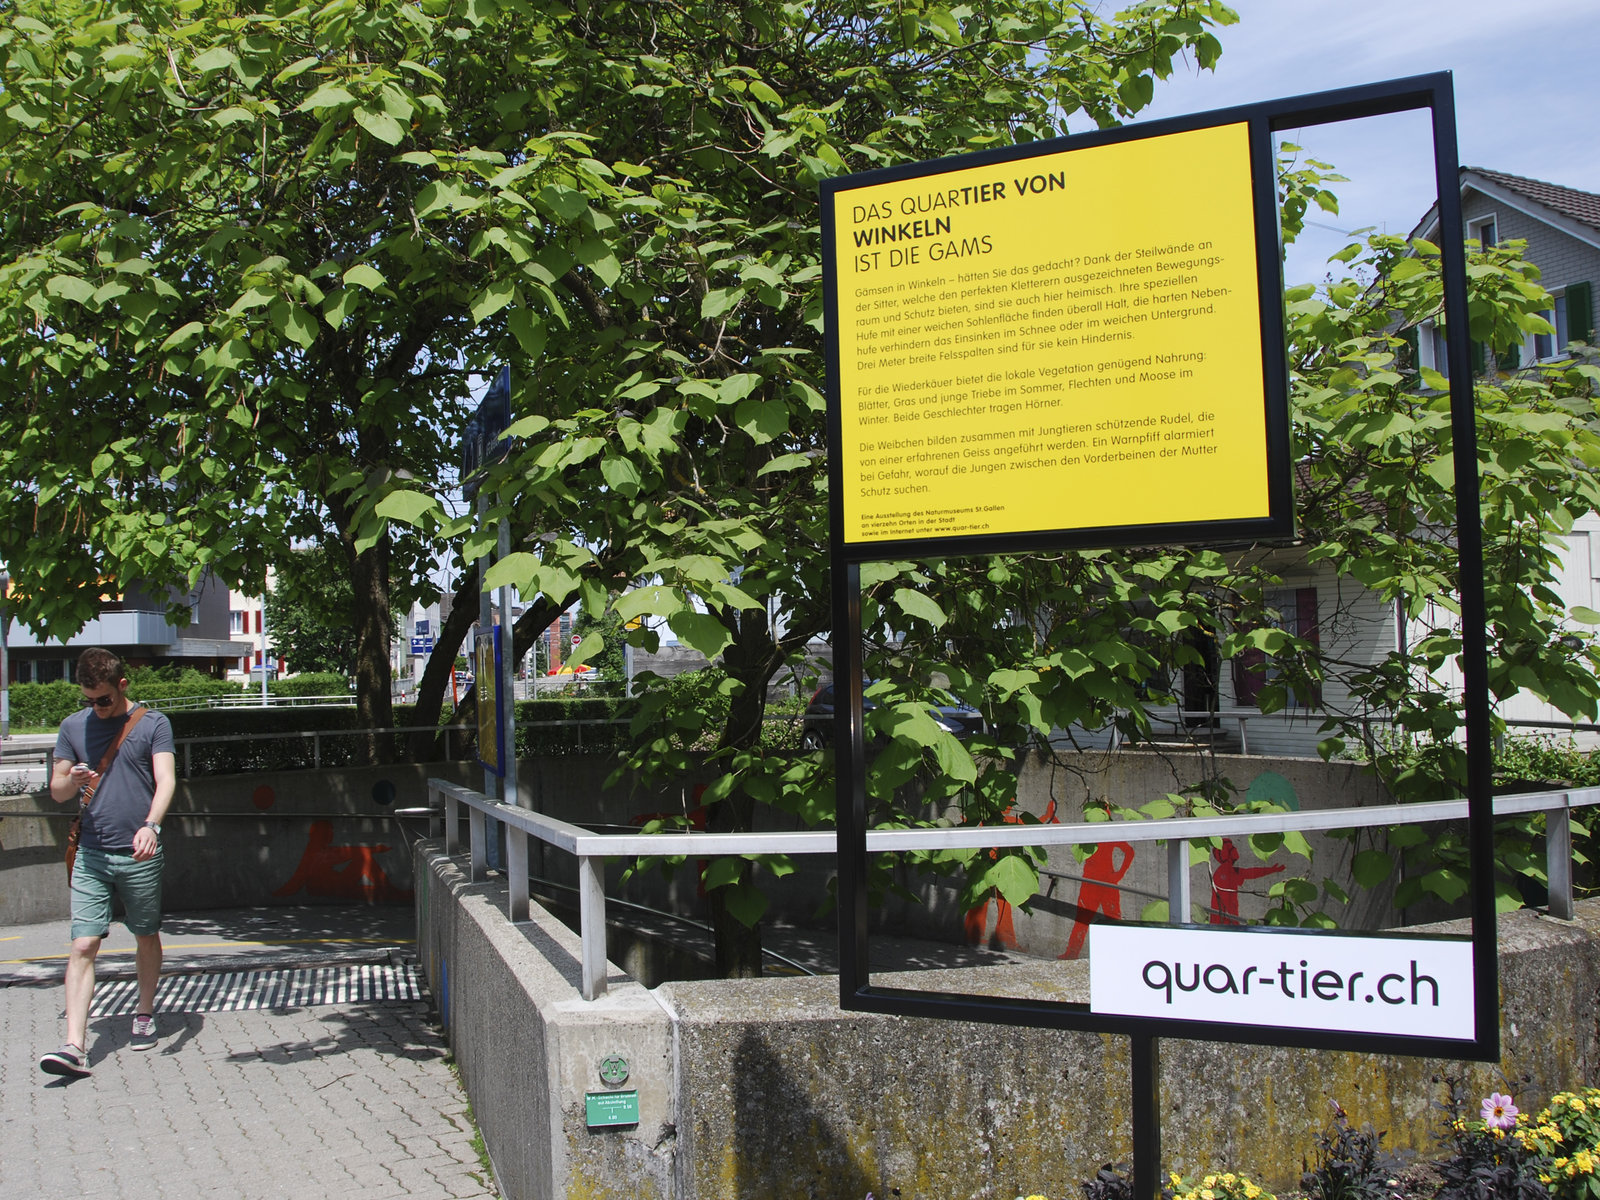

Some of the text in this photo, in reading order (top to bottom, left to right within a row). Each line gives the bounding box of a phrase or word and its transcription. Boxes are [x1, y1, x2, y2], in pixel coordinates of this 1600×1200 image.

[853, 171, 1065, 223] DAS QUARTIER VON
[853, 216, 950, 247] WINKELN
[855, 235, 992, 272] IST DIE GAMS
[855, 286, 894, 298] Gämsen
[909, 277, 946, 290] Winkeln
[958, 273, 990, 283] hätten
[993, 269, 1007, 278] Sie
[1011, 266, 1029, 276] das
[1032, 258, 1080, 275] gedacht?
[1084, 253, 1111, 266] Dank
[1115, 251, 1132, 262] der
[1136, 242, 1195, 259] Steilwände
[1198, 242, 1213, 250] an
[856, 257, 1224, 312] der Sitter, welche den perfekten Kletterern ausgezeichneten Bewegungs-
[856, 275, 1198, 327] raum und Schutz bieten, sind sie auch hier heimisch. Ihre speziellen
[857, 288, 1232, 341] Hufe mit einer weichen Sohlenfläche finden überall Halt, die harten Neben-
[857, 304, 1216, 356] hufe verhindern das Einsinken im Schnee oder im weichen Untergrund.
[858, 330, 1135, 371] Drei Meter breite Felsspalten sind für sie kein Hindernis.
[858, 353, 1206, 396] Für die Wiederkäuer bietet die lokale Vegetation genügend Nahrung:
[859, 369, 1193, 411] Blätter, Gras und junge Triebe im Sommer, Flechten und Moose im
[859, 400, 1064, 426] Winter. Beide Geschlechter tragen Hörner.
[860, 412, 1215, 452] Die Weibchen bilden zusammen mit Jungtieren schützende Rudel, die
[860, 428, 1214, 467] von einer erfahrenen Geiss angeführt werden. Ein Warnpfiff alarmiert
[861, 445, 1218, 482] bei Gefahr, worauf die Jungen zwischen den Vorderbeinen der Mutter
[861, 484, 931, 497] Schutz suchen.
[926, 508, 974, 516] Naturmuseums
[935, 523, 990, 531] www.quar-tier.ch
[1142, 960, 1439, 1006] quar-tier.ch
